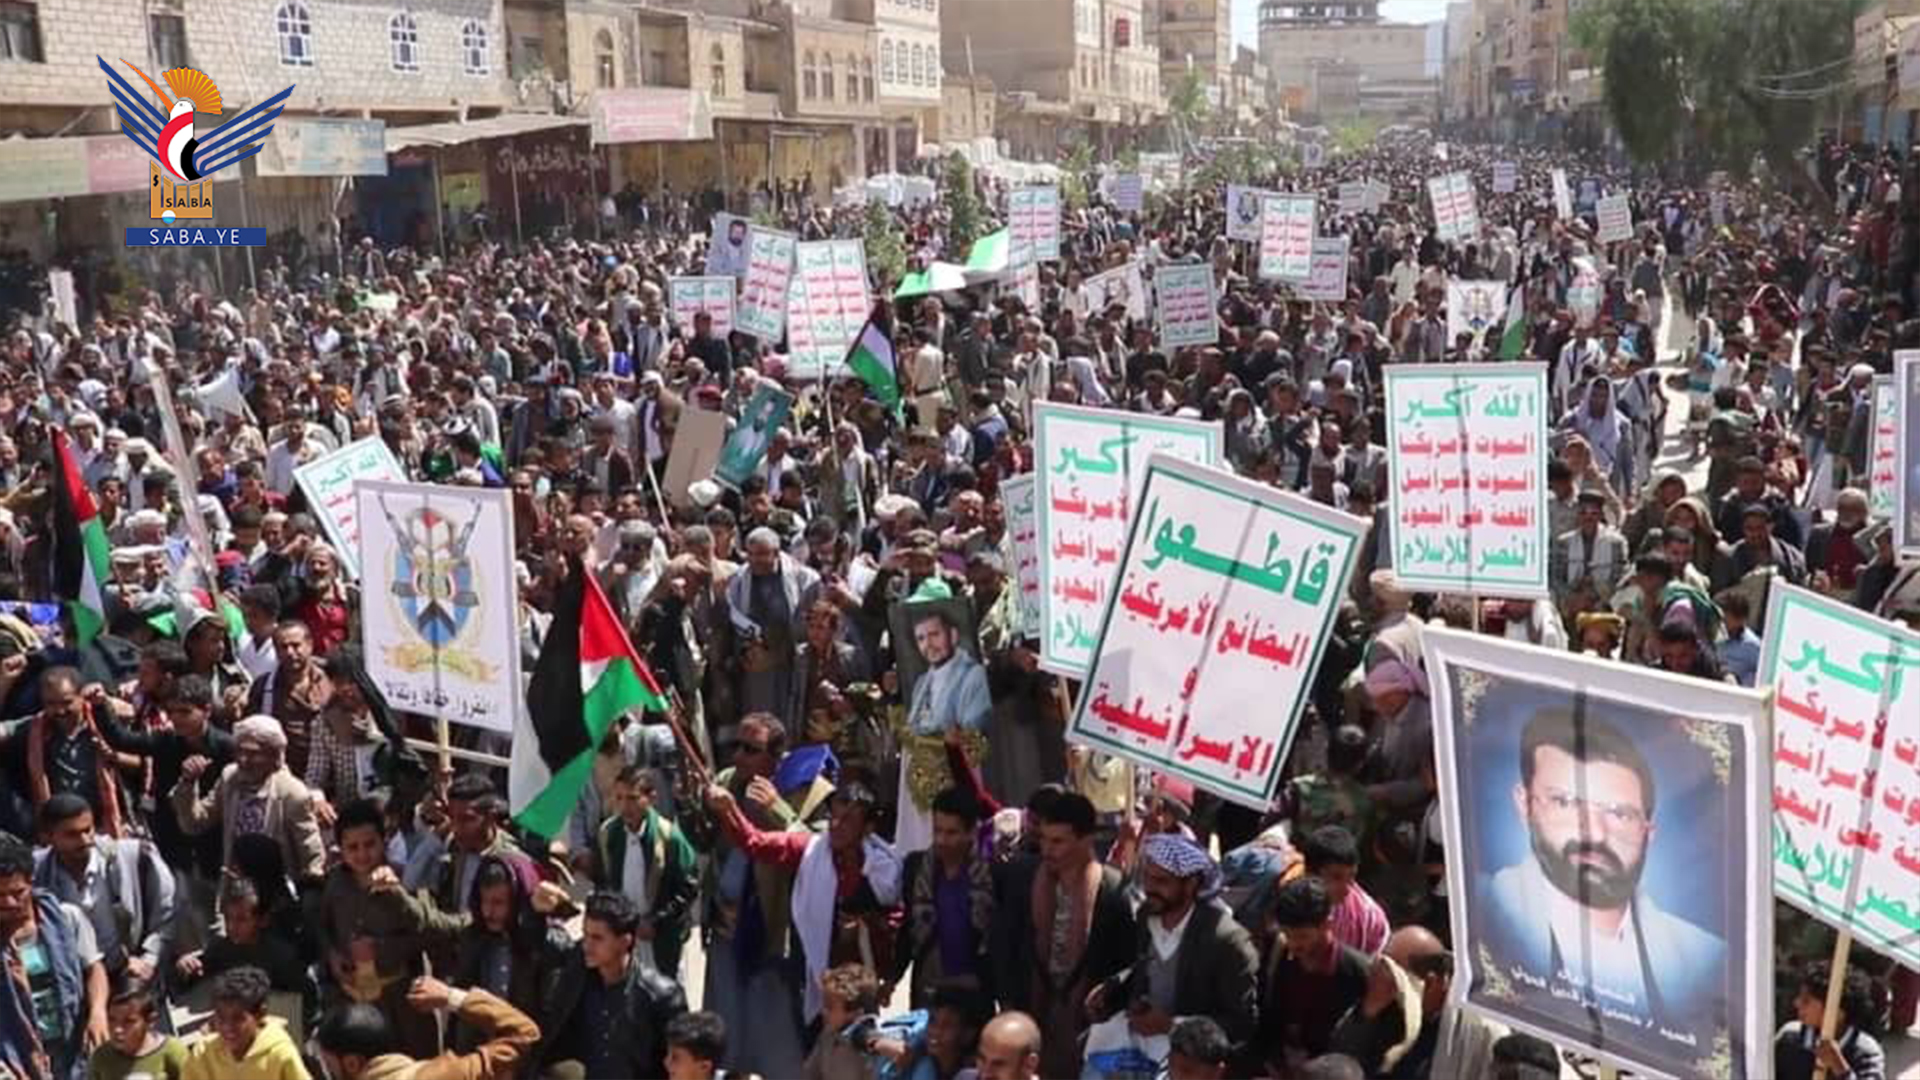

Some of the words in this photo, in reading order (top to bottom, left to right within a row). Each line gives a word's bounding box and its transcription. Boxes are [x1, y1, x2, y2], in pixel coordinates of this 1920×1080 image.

[1398, 380, 1478, 428] أكبر
[1484, 384, 1536, 417] الله
[1475, 432, 1535, 460] الموت
[1476, 468, 1535, 496] الموت
[1401, 502, 1450, 529] اليهود
[1490, 502, 1536, 527] اللعنة
[1142, 496, 1337, 606] قاطعوا
[1402, 534, 1471, 572] للإسلام
[1477, 535, 1536, 572] النصر
[1120, 571, 1218, 640] الأمريكية
[1216, 610, 1310, 671] البضائع
[1180, 666, 1198, 700] و
[1090, 681, 1275, 781] الإسرائيلية
[1773, 784, 1832, 829] اليهو
[1838, 821, 1882, 853] على
